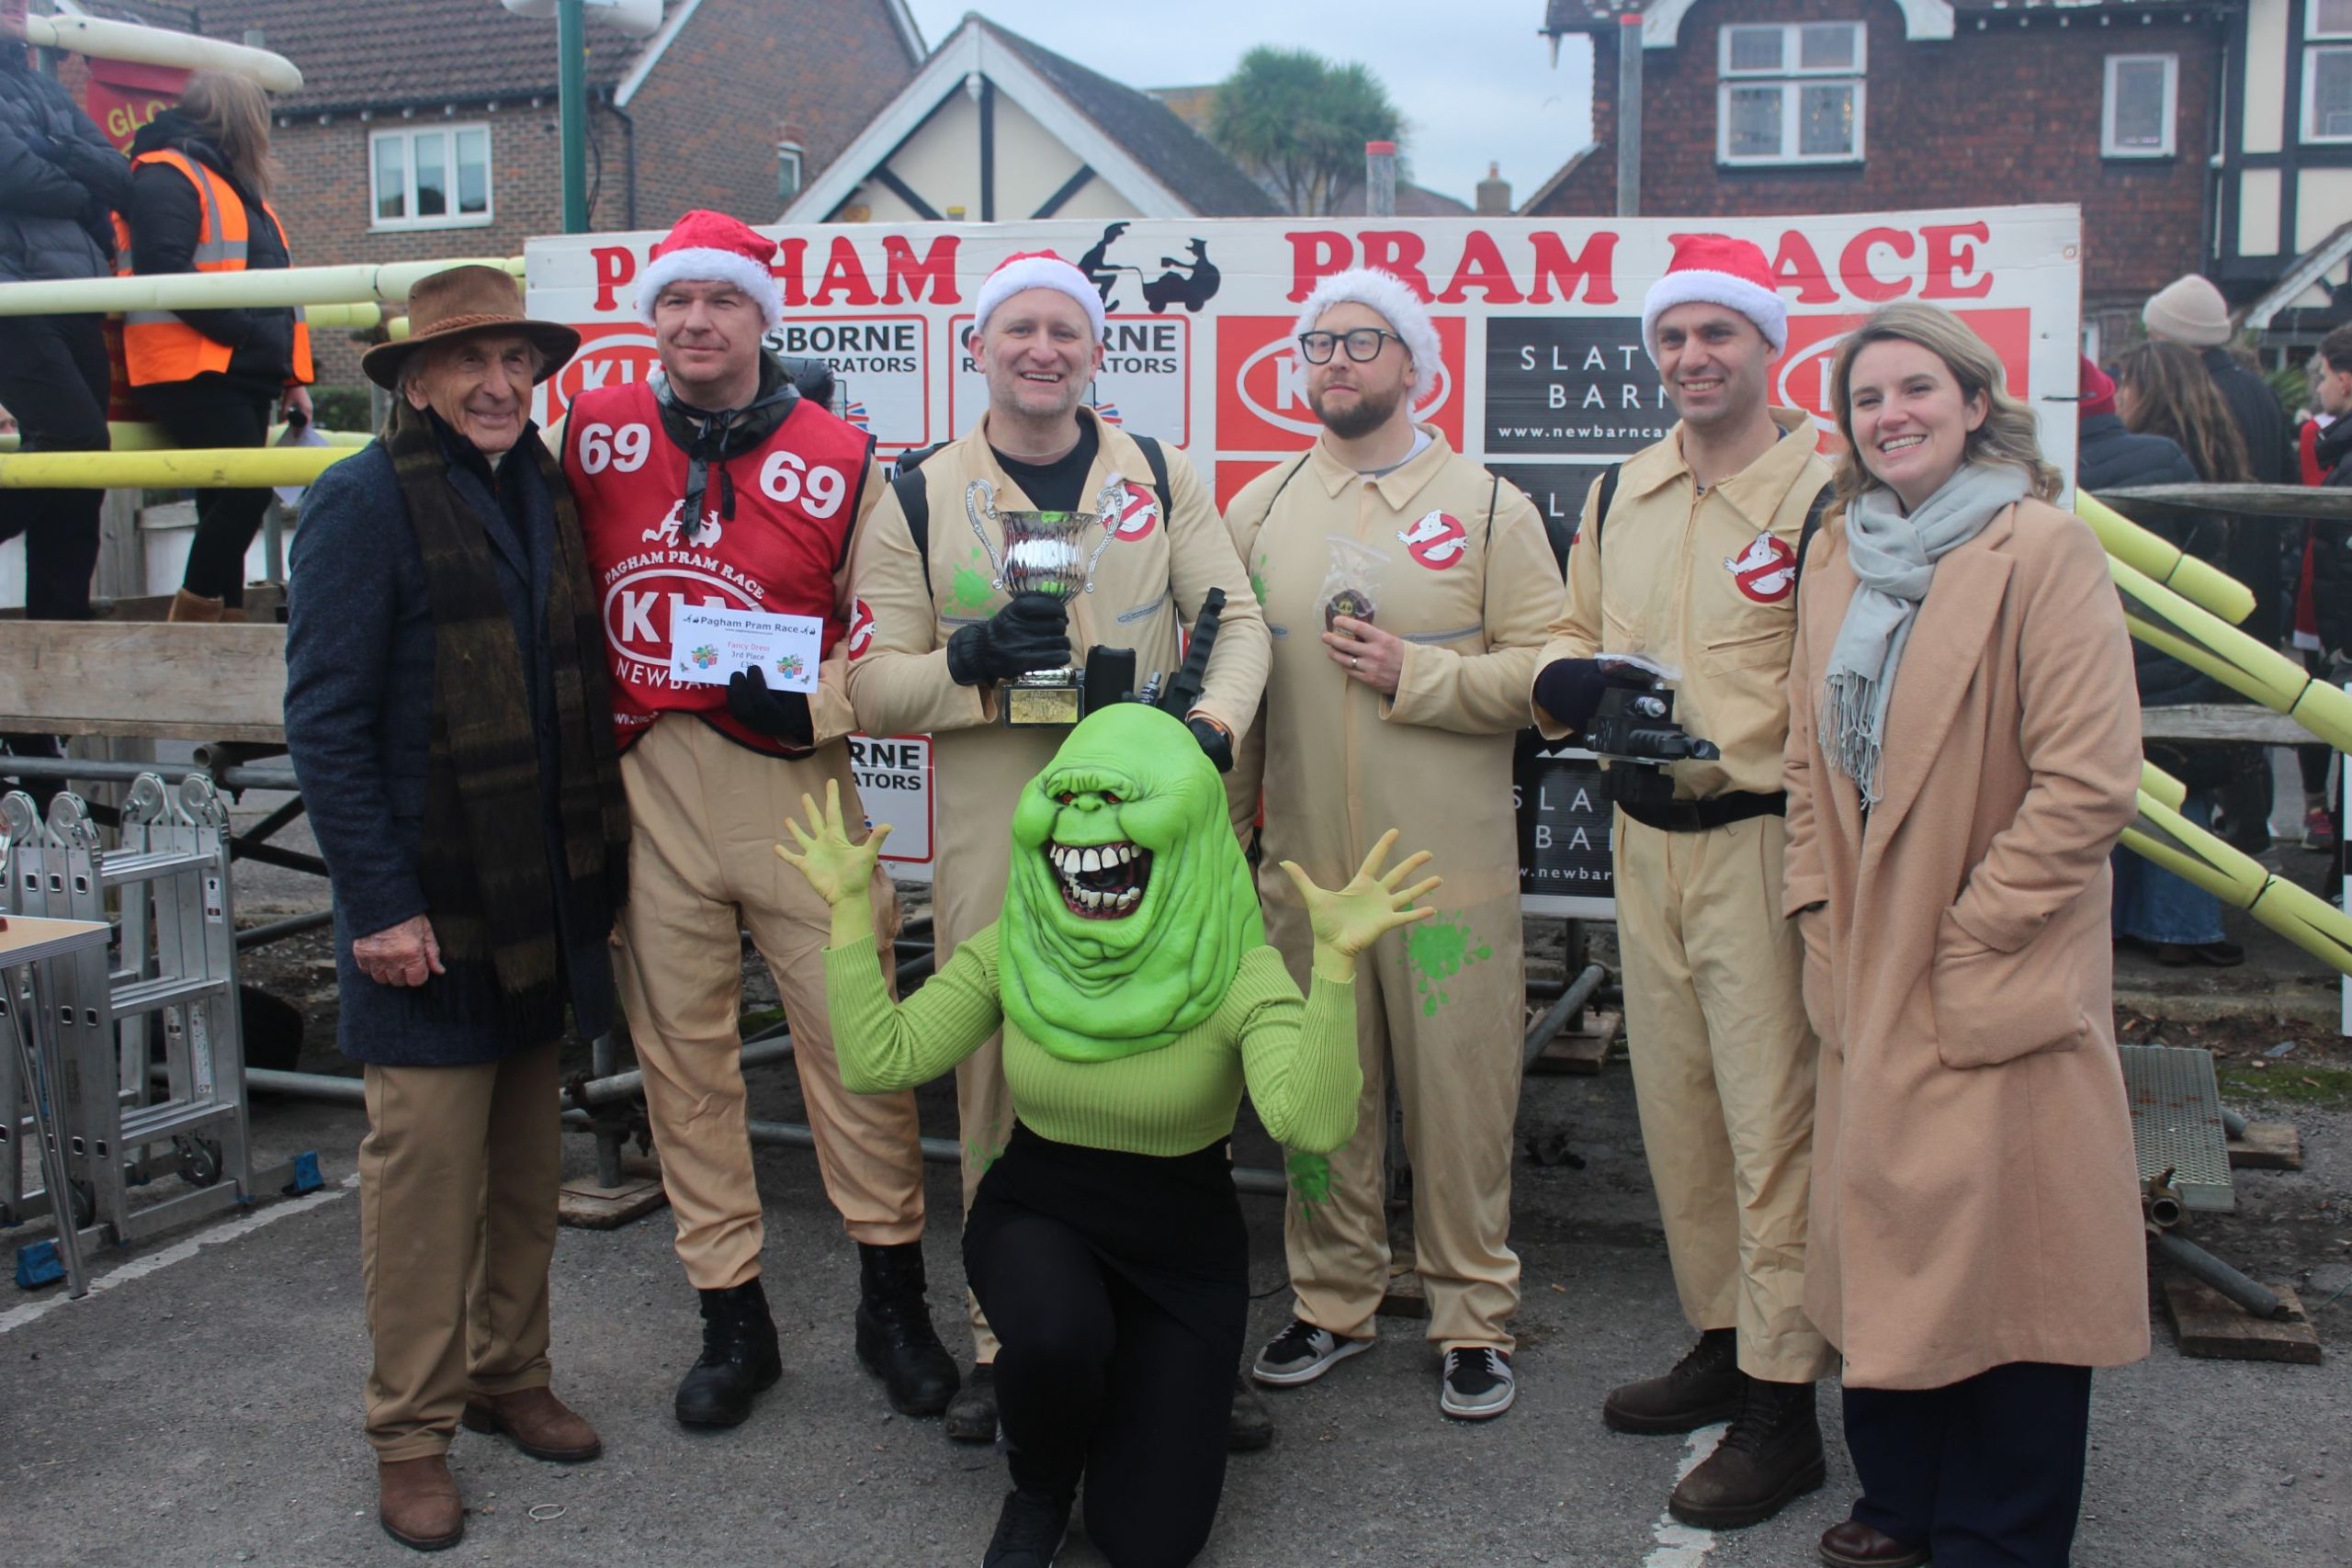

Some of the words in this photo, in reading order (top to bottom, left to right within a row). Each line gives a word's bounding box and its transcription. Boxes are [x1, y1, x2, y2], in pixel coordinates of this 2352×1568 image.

[1284, 230, 1620, 305] PRAM
[1668, 220, 1994, 304] ACE
[766, 325, 916, 353] SBORNE
[1521, 345, 1657, 371] SLAT
[579, 423, 651, 475] 69
[760, 450, 846, 519] 69
[605, 550, 664, 585] PAGHAM
[668, 551, 719, 571] PRAM
[719, 567, 765, 600] RACE
[700, 615, 742, 629] Pagham
[745, 620, 772, 631] Pram
[775, 624, 798, 634] Race
